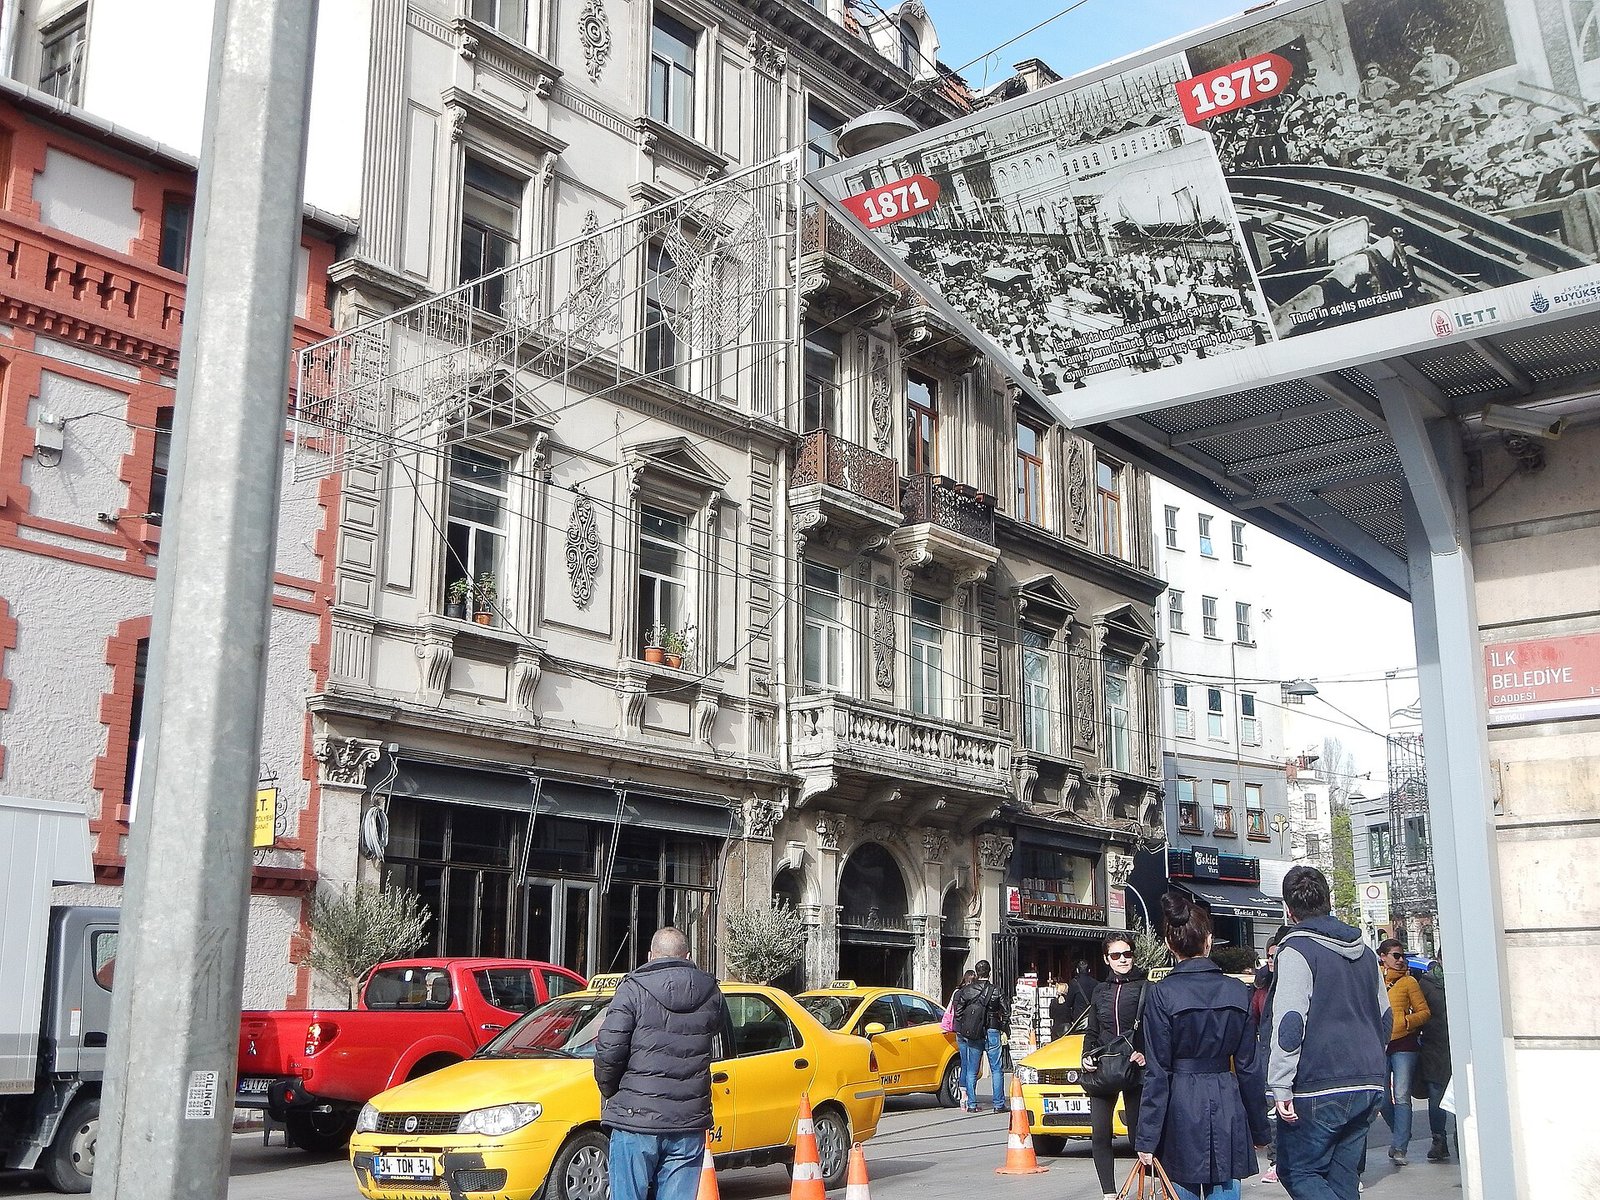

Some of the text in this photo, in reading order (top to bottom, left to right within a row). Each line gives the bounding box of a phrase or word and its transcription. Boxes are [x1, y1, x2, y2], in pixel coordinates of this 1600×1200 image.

[1192, 58, 1279, 115] 1875
[863, 180, 929, 224] 1871
[1290, 287, 1404, 325] Tünel'in açılış merasimi
[1053, 332, 1099, 351] İstanbul'da
[1100, 325, 1123, 341] toplu
[1122, 318, 1159, 334] ulaşımın
[1186, 303, 1219, 319] sayılan
[1220, 296, 1237, 309] atlı
[1454, 307, 1497, 328] İETT
[1060, 346, 1111, 365] tramvayların
[1111, 338, 1145, 356] hizmete
[1146, 330, 1166, 347] giriş
[1065, 370, 1083, 381] aynı
[1083, 359, 1120, 376] zamanda
[1120, 349, 1154, 367] İETT'nin
[1154, 343, 1187, 358] kuruluş
[1215, 326, 1254, 344] Tophane
[1491, 649, 1516, 667] İLK
[1492, 667, 1573, 689] BELEDİYE
[1194, 851, 1218, 866] Eskici
[881, 1074, 901, 1085] THM 97
[1049, 1101, 1059, 1111] 34
[1065, 1101, 1081, 1111] TJU
[709, 1126, 722, 1142] 54
[380, 1159, 390, 1173] 34
[419, 1159, 431, 1174] 54
